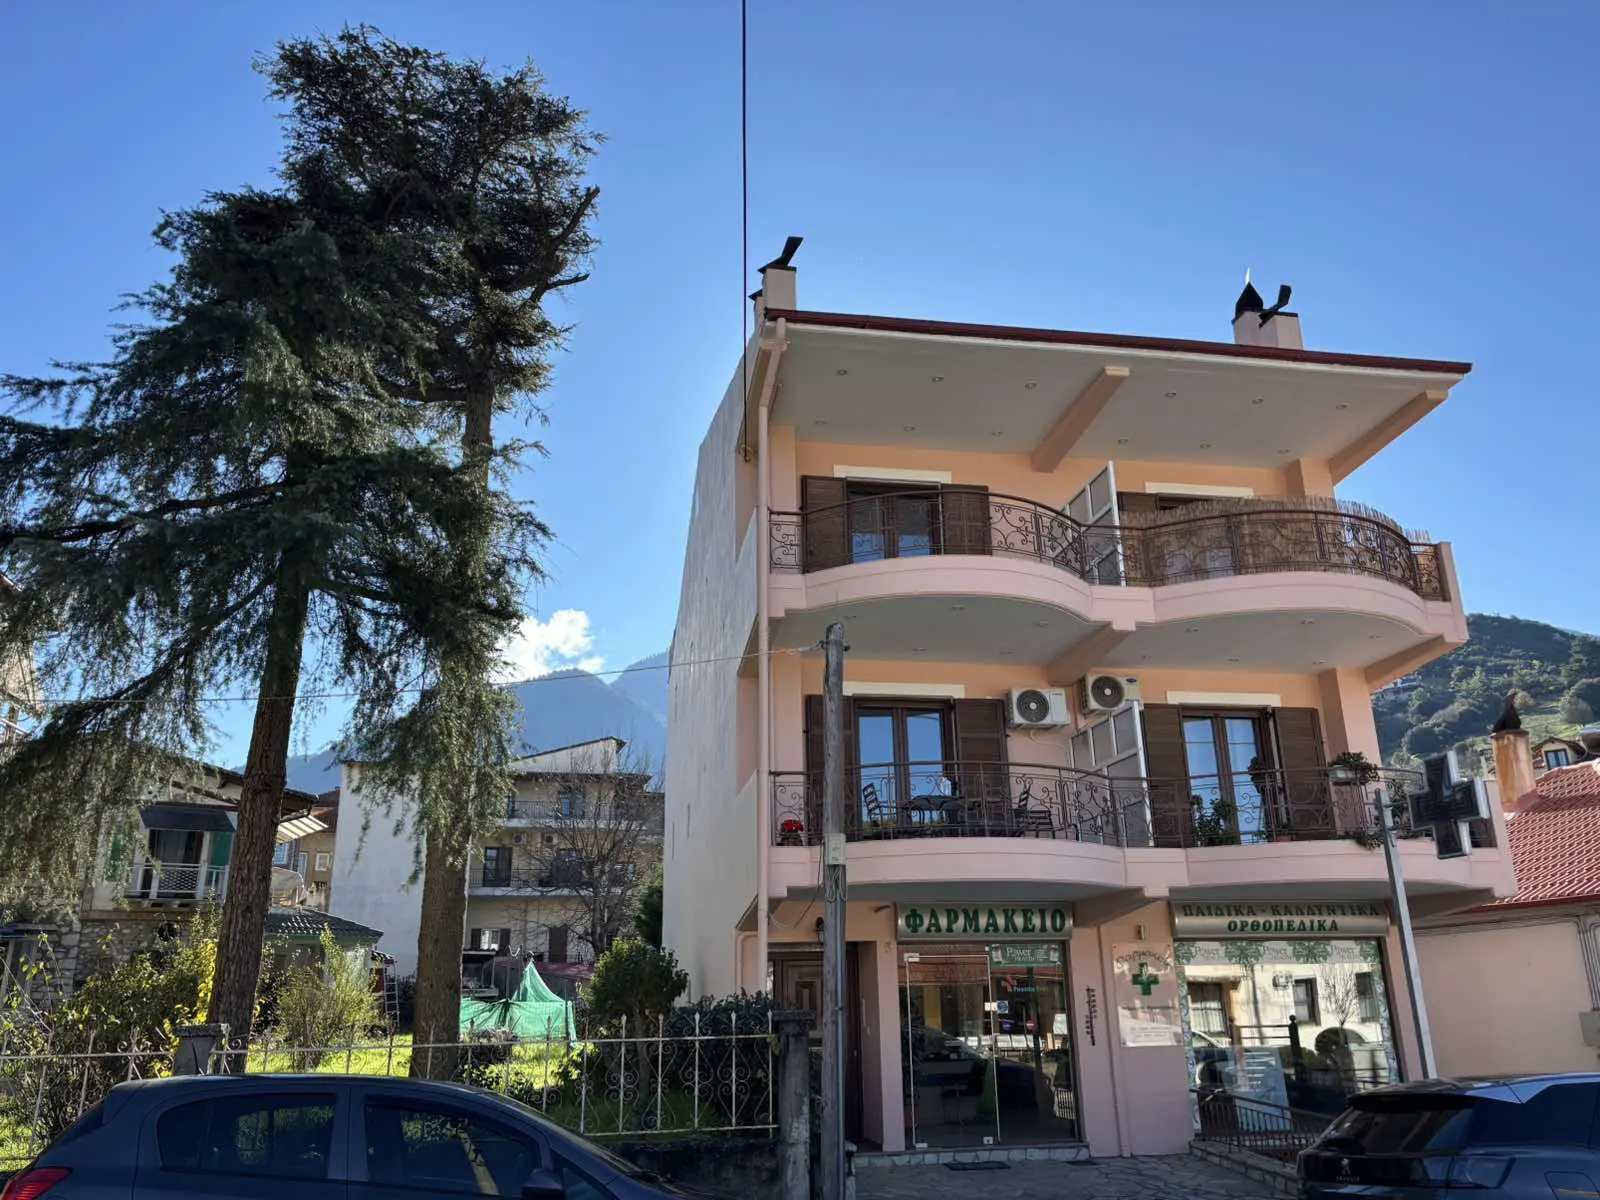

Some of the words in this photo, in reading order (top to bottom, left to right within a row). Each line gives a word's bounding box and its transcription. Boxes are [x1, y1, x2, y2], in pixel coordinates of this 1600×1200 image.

[1183, 904, 1257, 917] ΠΑΙΔΙΚΑ
[1271, 904, 1379, 917] ΚΑΛΛΥΝΤΙΚΑ
[905, 908, 1066, 933] ΦΑΡΜΑΚΕΙΟ
[1227, 919, 1339, 932] ΟΡΘΟΠΕΔΙΚΑ
[1006, 947, 1031, 958] Power
[1263, 945, 1288, 956] Power
[1331, 944, 1355, 955] Power
